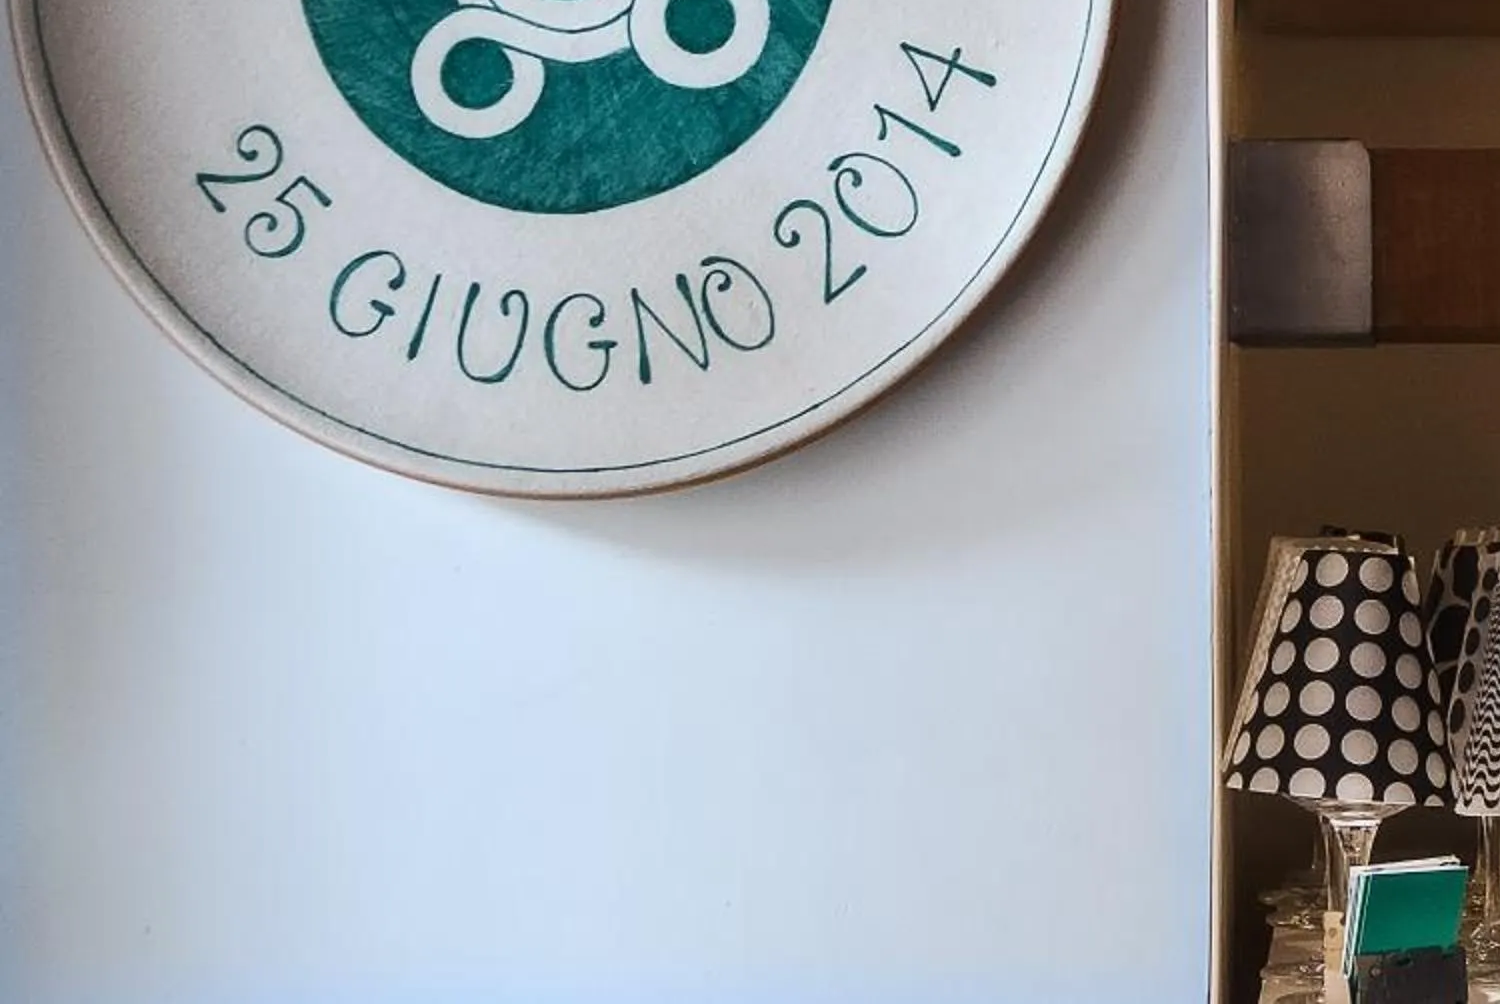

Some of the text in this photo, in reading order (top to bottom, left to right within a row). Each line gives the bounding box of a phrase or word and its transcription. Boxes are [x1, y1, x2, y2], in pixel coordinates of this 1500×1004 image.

[196, 40, 997, 391] 25 GIUGNO 2014
